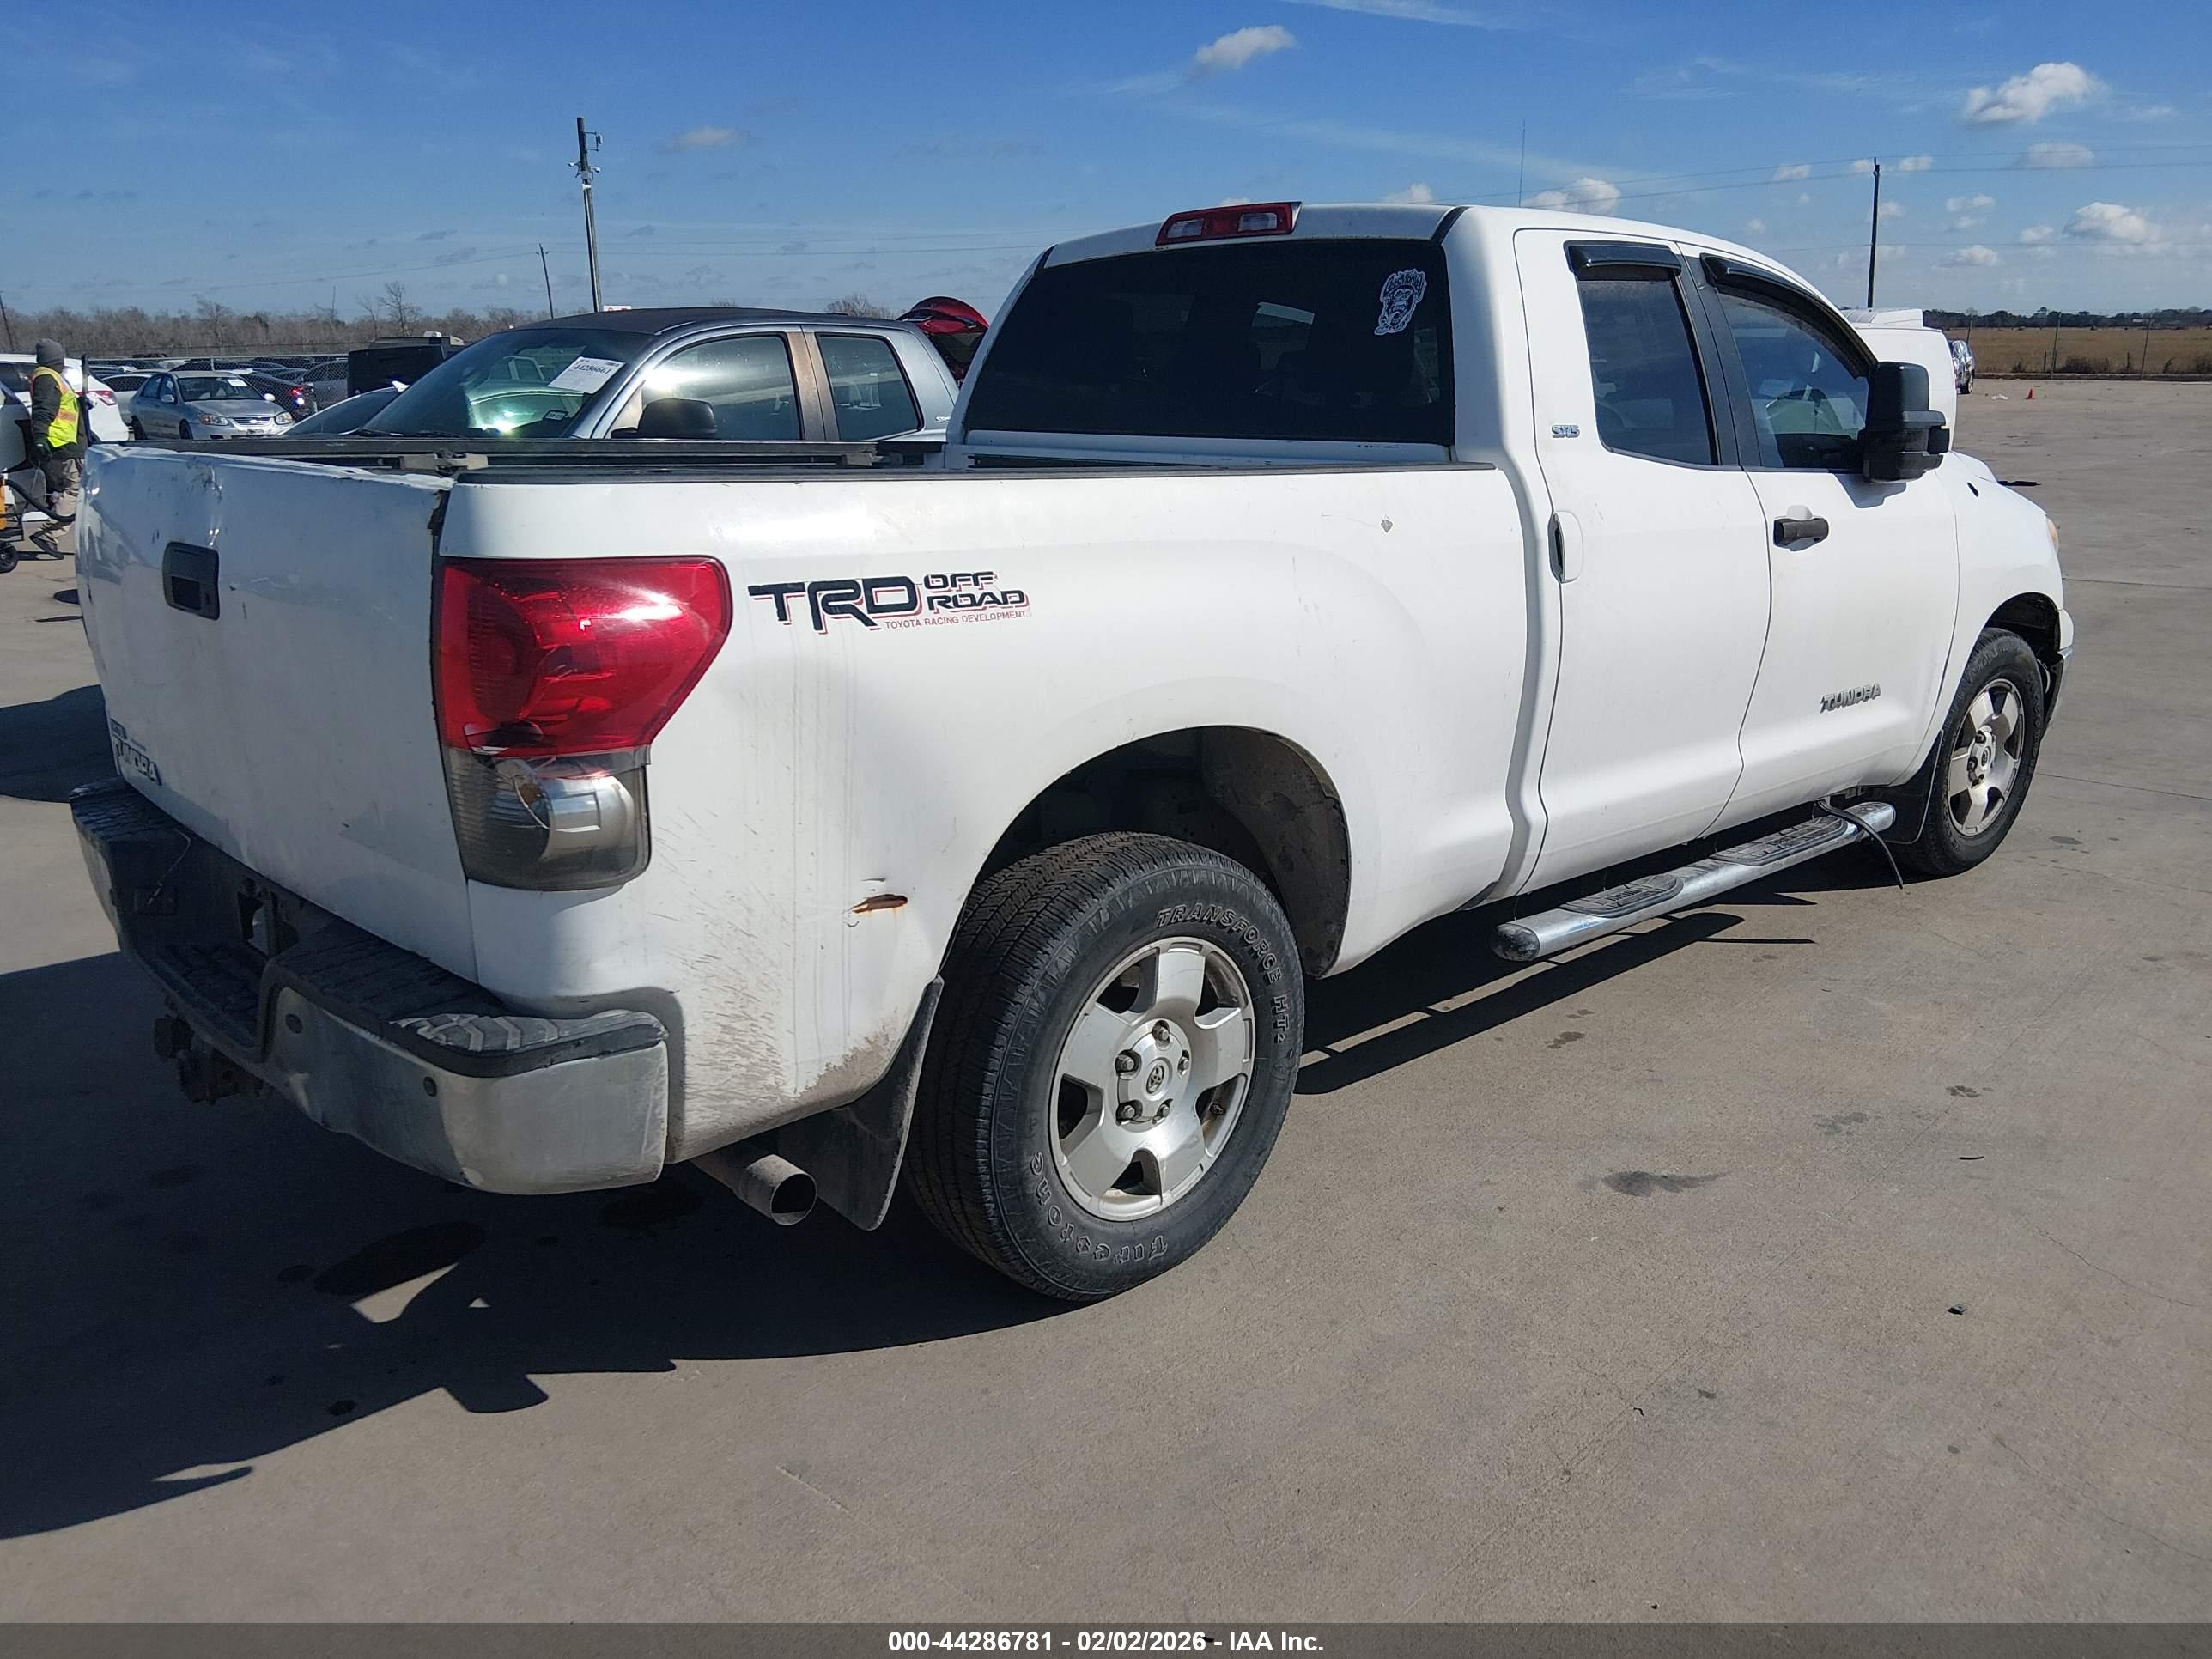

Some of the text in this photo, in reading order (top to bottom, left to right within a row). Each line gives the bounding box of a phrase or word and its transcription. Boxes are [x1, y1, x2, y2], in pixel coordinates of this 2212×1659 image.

[924, 571, 997, 591] OFF
[748, 576, 923, 635] TRD
[927, 590, 1030, 613] ROAD
[885, 610, 1026, 629] TOYOTA RACING DEVELOPMENT
[1820, 684, 1881, 714] TUNDRA
[1157, 902, 1283, 985] TRANSFORCE
